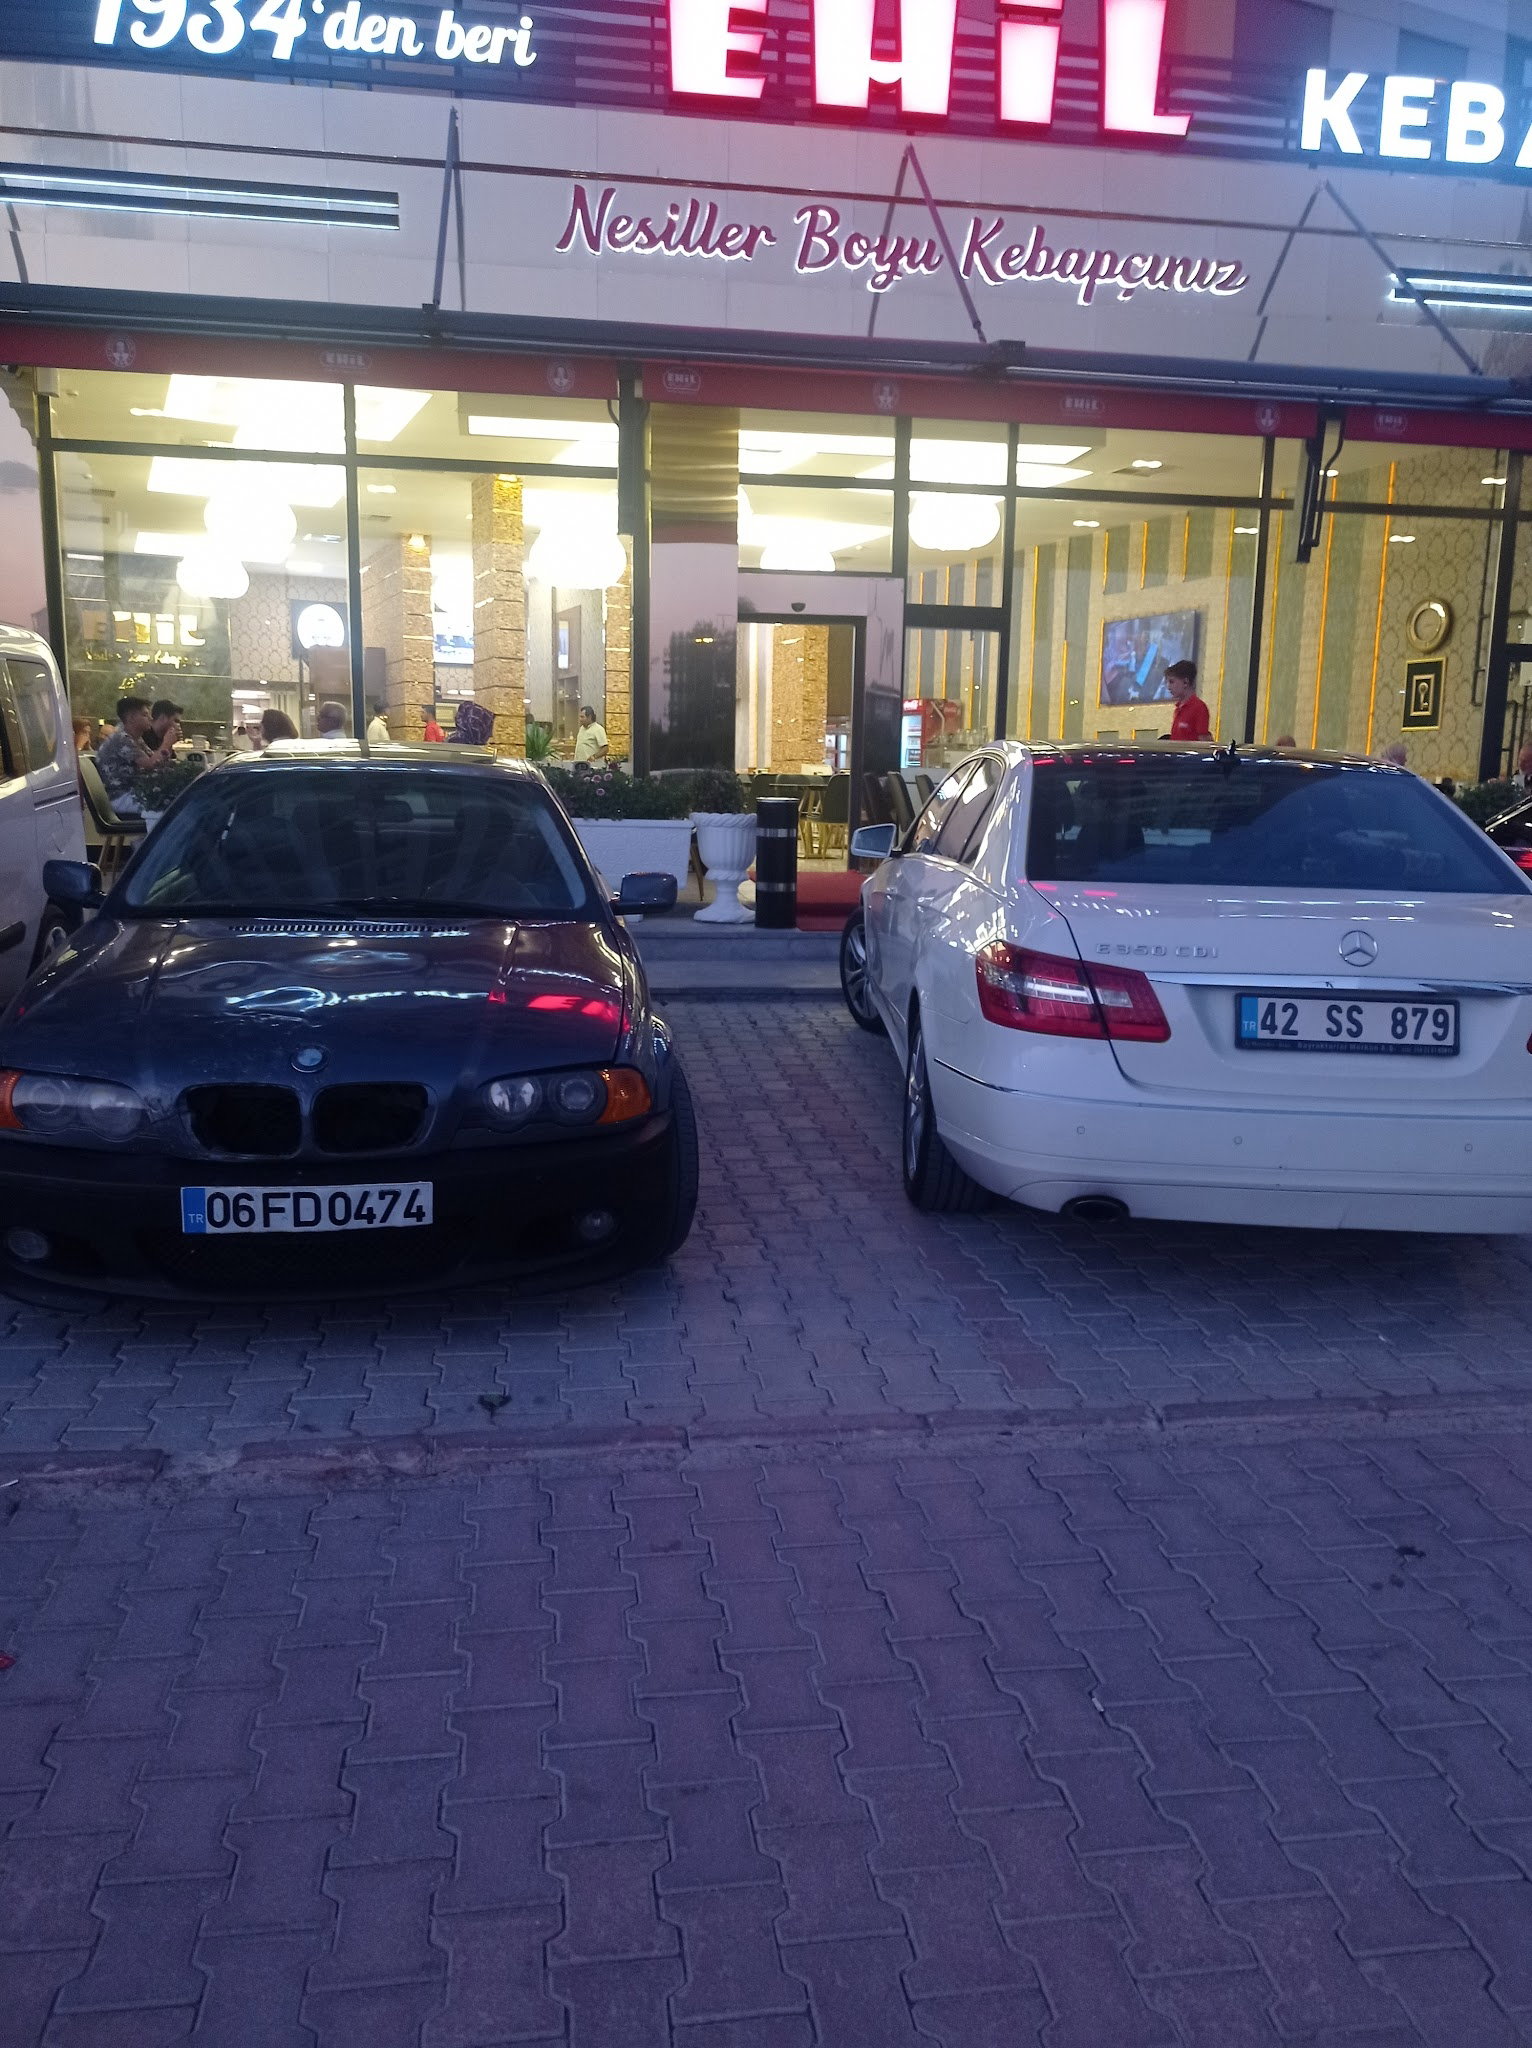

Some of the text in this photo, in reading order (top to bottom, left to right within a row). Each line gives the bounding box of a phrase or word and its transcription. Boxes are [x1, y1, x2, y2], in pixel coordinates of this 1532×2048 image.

[434, 9, 537, 67] beri
[1300, 68, 1532, 168] KEB
[555, 183, 777, 262] Nesiller
[794, 204, 944, 293] Boyu
[1175, 945, 1218, 958] CDI
[1242, 1021, 1257, 1030] TR
[1260, 1002, 1450, 1041] 42 SS 879
[188, 1213, 205, 1224] TR
